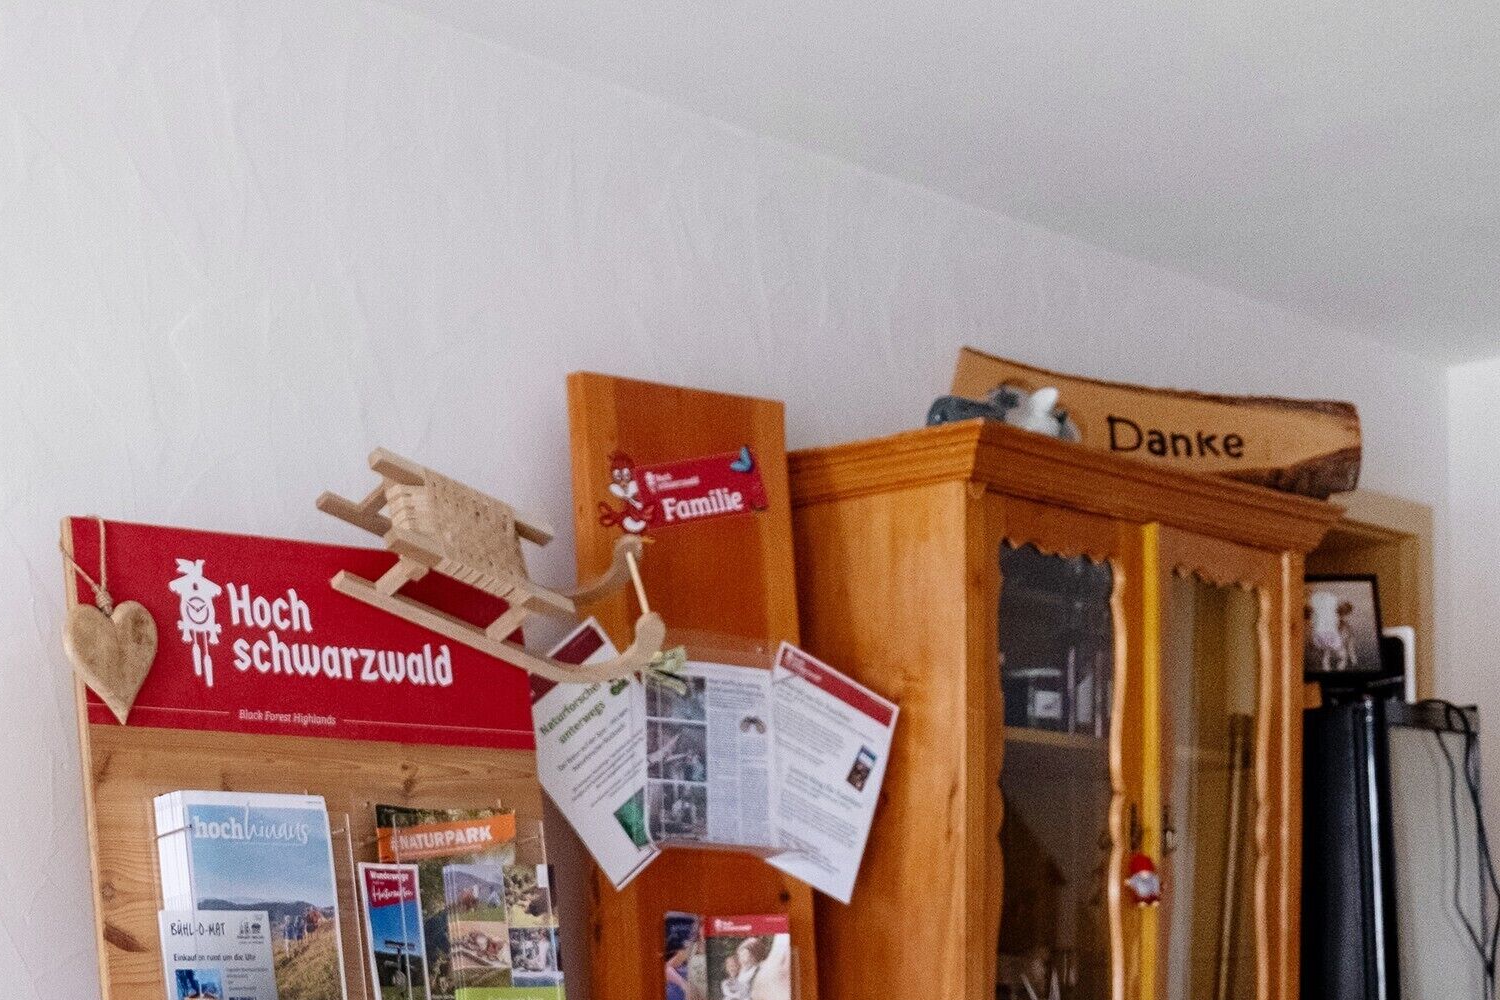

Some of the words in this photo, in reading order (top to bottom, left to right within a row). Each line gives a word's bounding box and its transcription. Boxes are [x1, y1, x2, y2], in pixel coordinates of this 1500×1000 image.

[1106, 416, 1246, 459] Danke
[661, 488, 745, 522] Familie
[227, 583, 313, 632] Hoch
[234, 631, 453, 687] schwarzwald
[239, 708, 263, 721] Black
[264, 710, 292, 722] Forest
[293, 712, 337, 727] Highlands
[539, 681, 601, 736] Naturforsche
[170, 920, 226, 937] BÜHL-O-MAT
